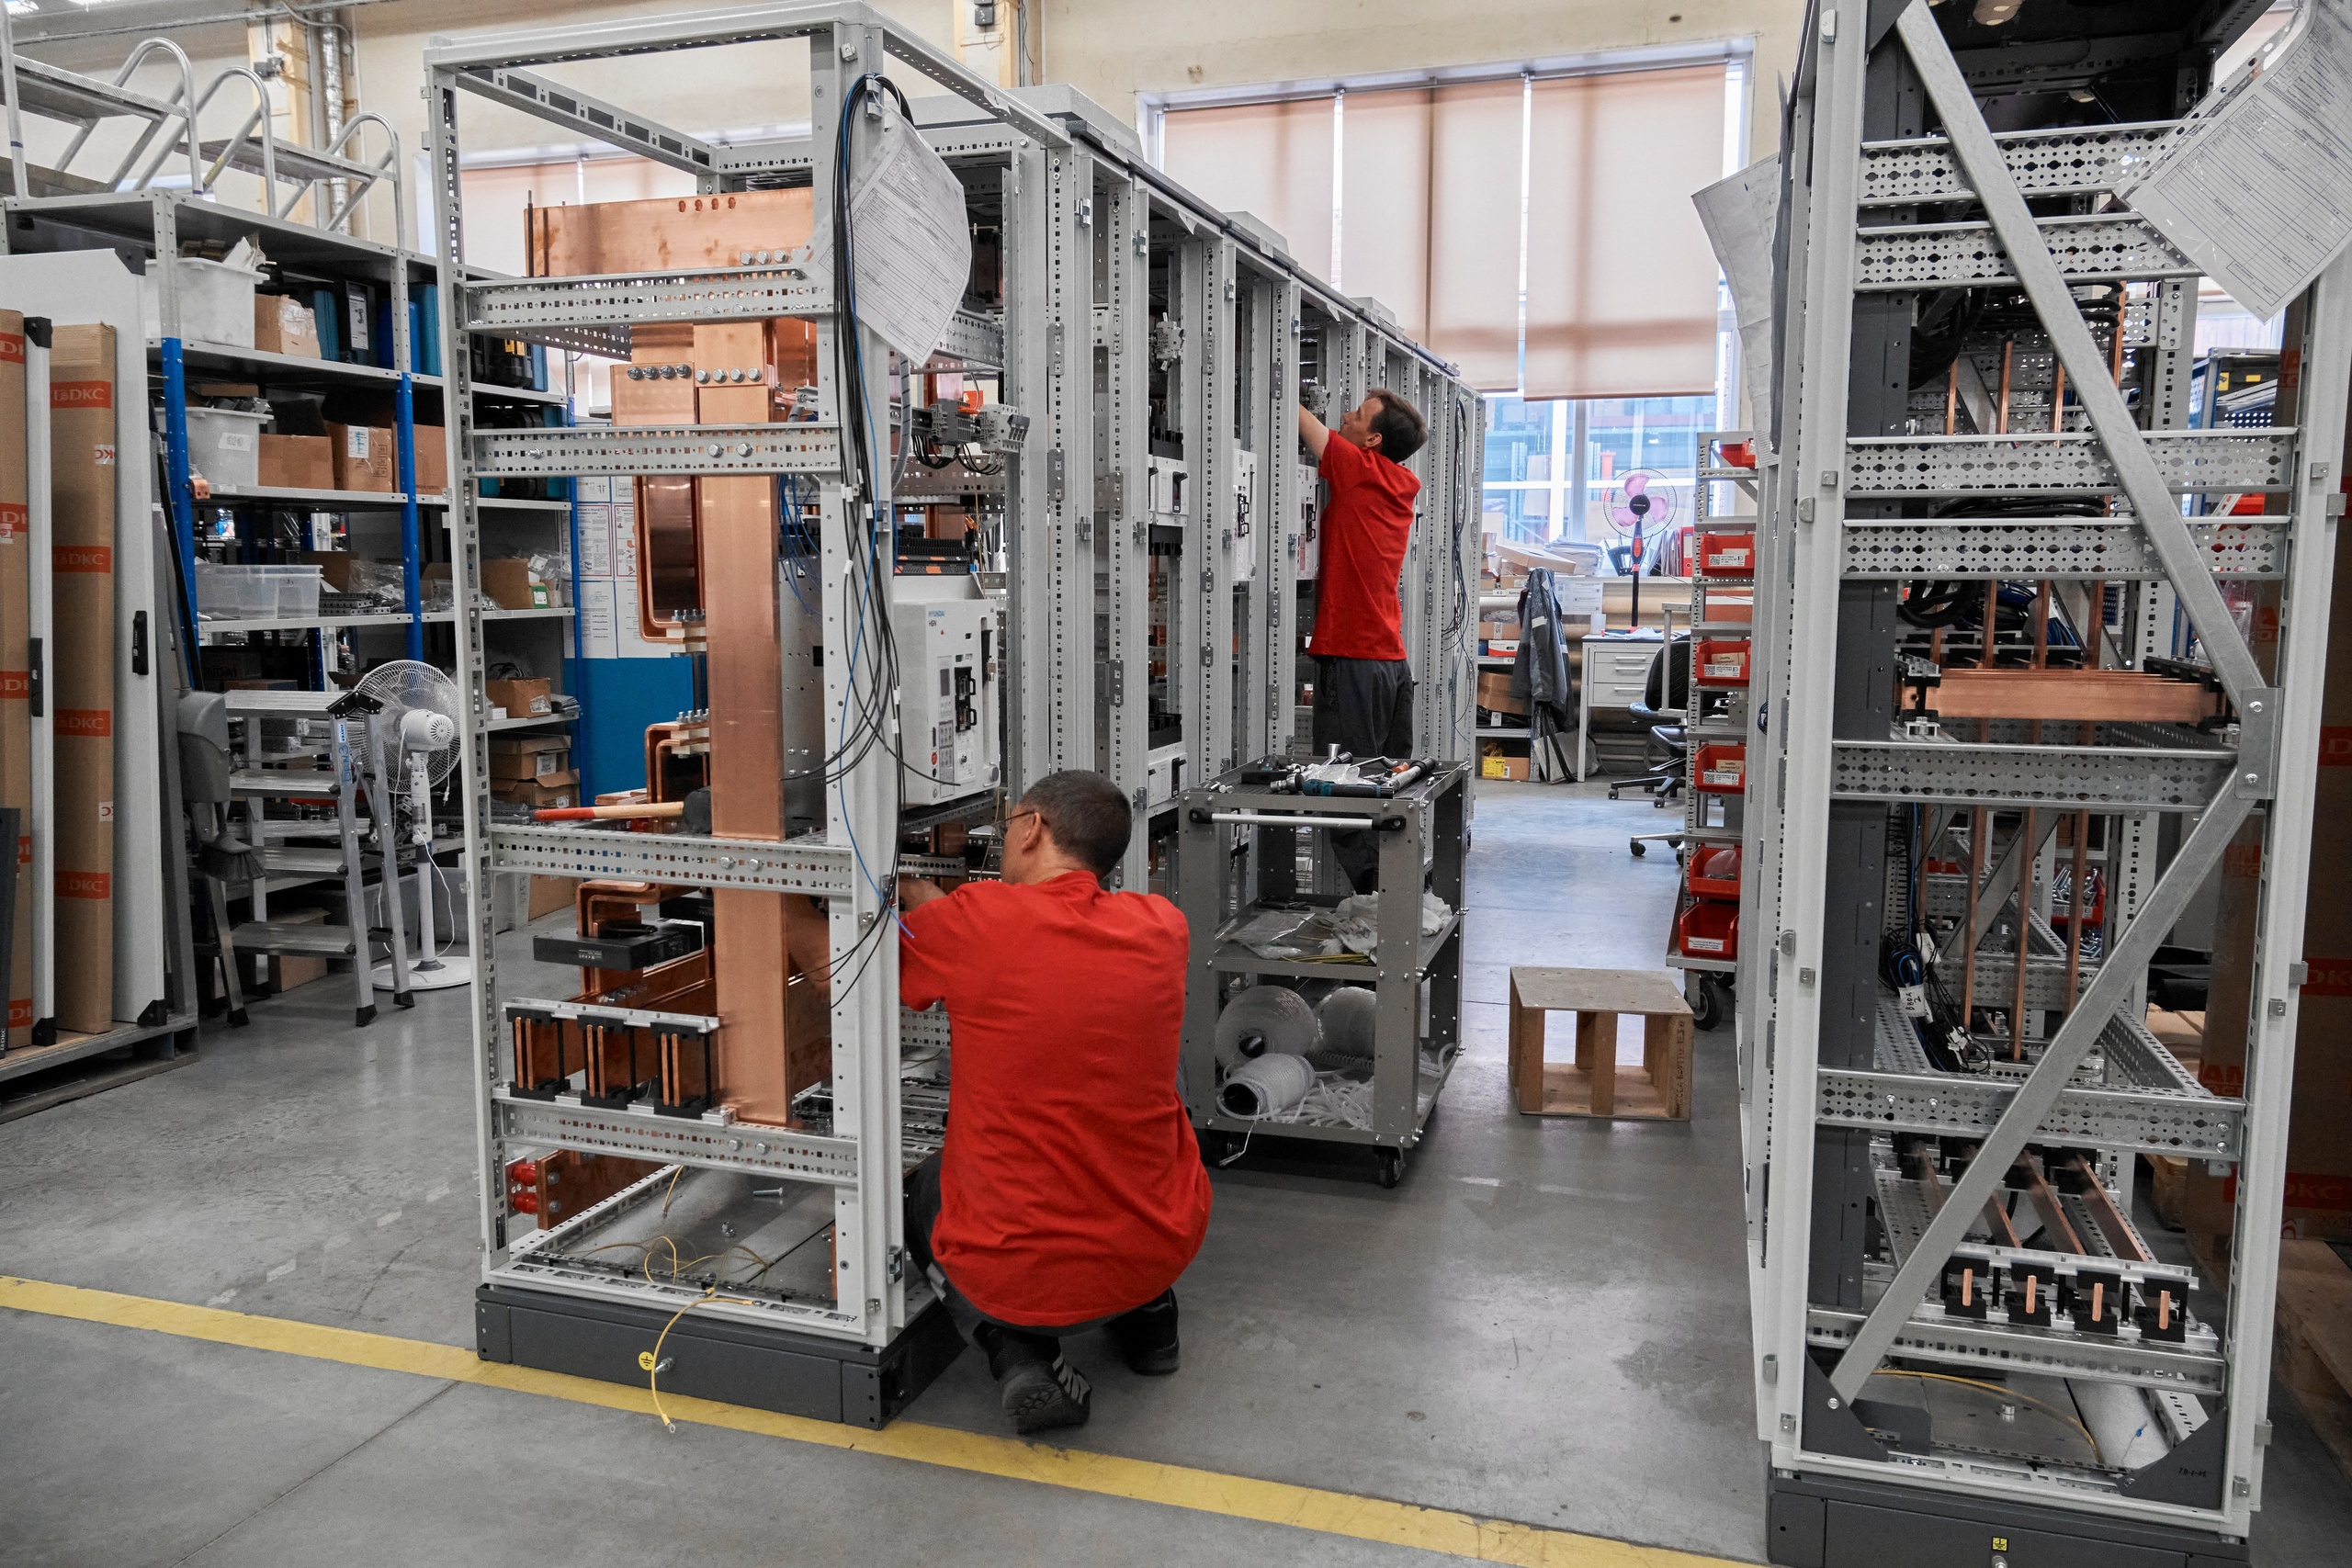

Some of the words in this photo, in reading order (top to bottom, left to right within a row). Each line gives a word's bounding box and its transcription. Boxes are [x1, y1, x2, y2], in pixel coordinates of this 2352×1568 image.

[70, 388, 105, 400] DKC
[95, 449, 113, 459] KC
[69, 553, 104, 566] DKC
[69, 716, 105, 729] DKC
[69, 878, 104, 892] DKC
